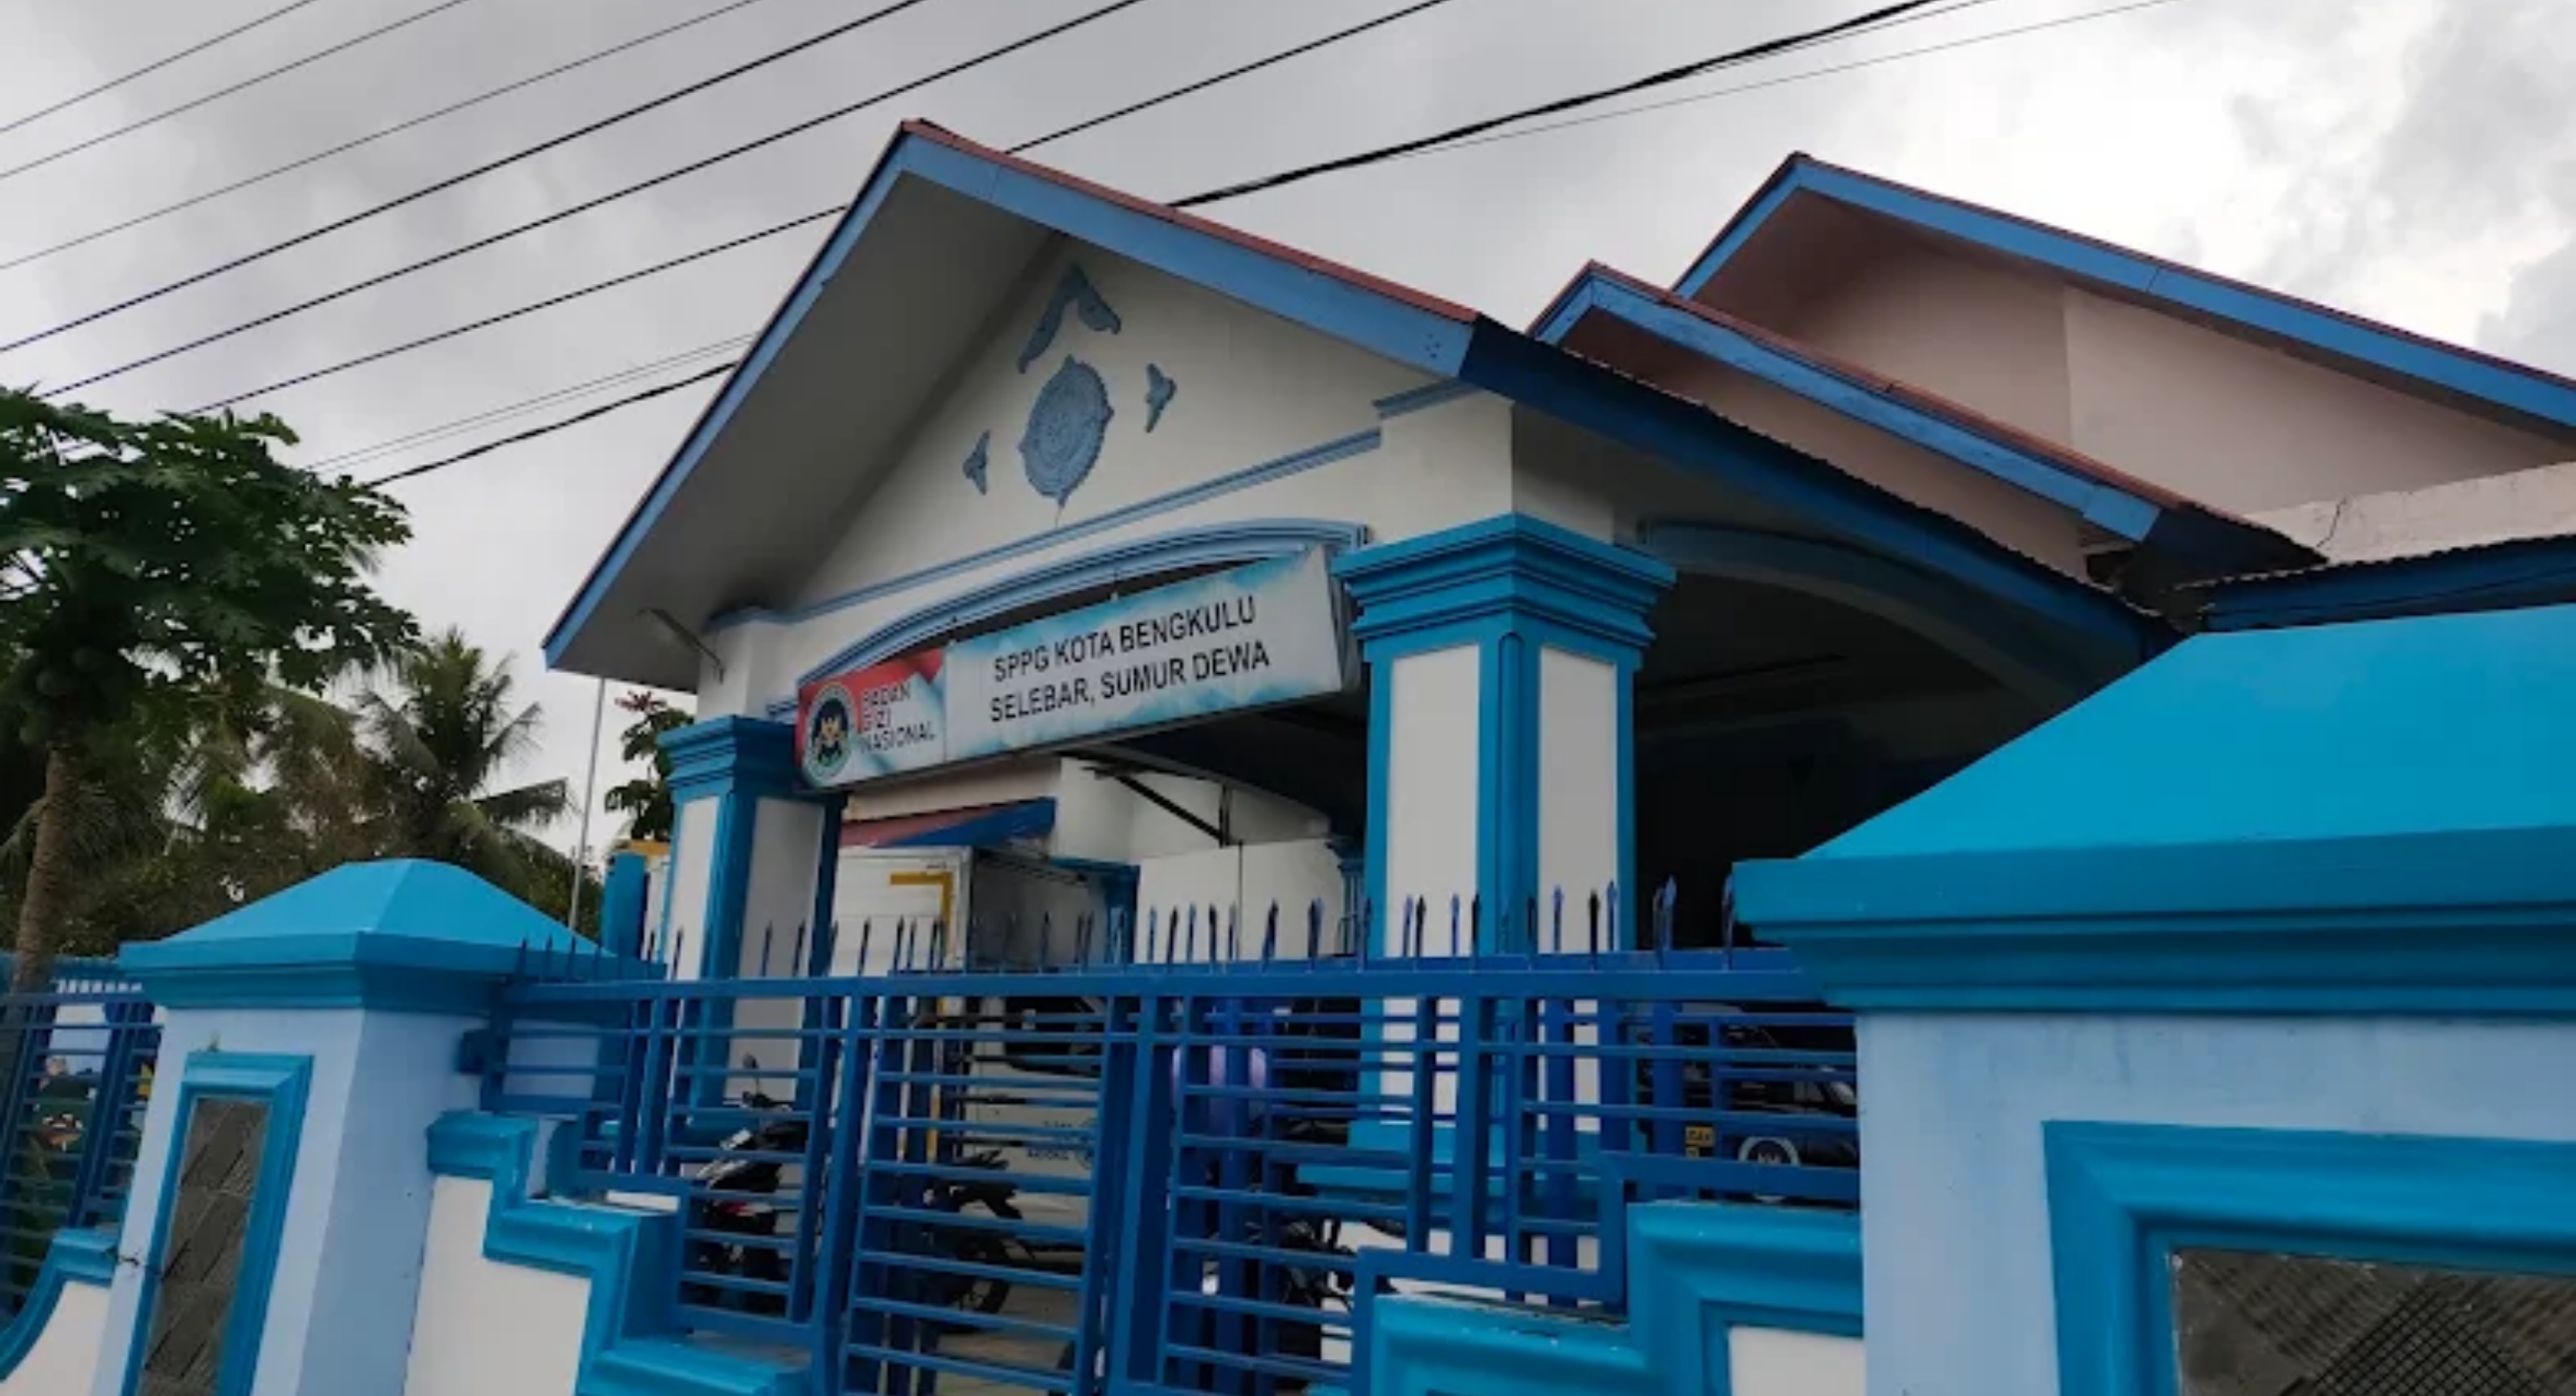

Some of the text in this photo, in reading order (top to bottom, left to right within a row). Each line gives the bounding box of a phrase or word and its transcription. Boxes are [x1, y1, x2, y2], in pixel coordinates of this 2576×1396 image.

[990, 638, 1270, 723] SELEBAR, SUMUR DEWA
[994, 594, 1256, 683] SPPG KOTA BENGKULU
[860, 720, 937, 754] NASIONAL
